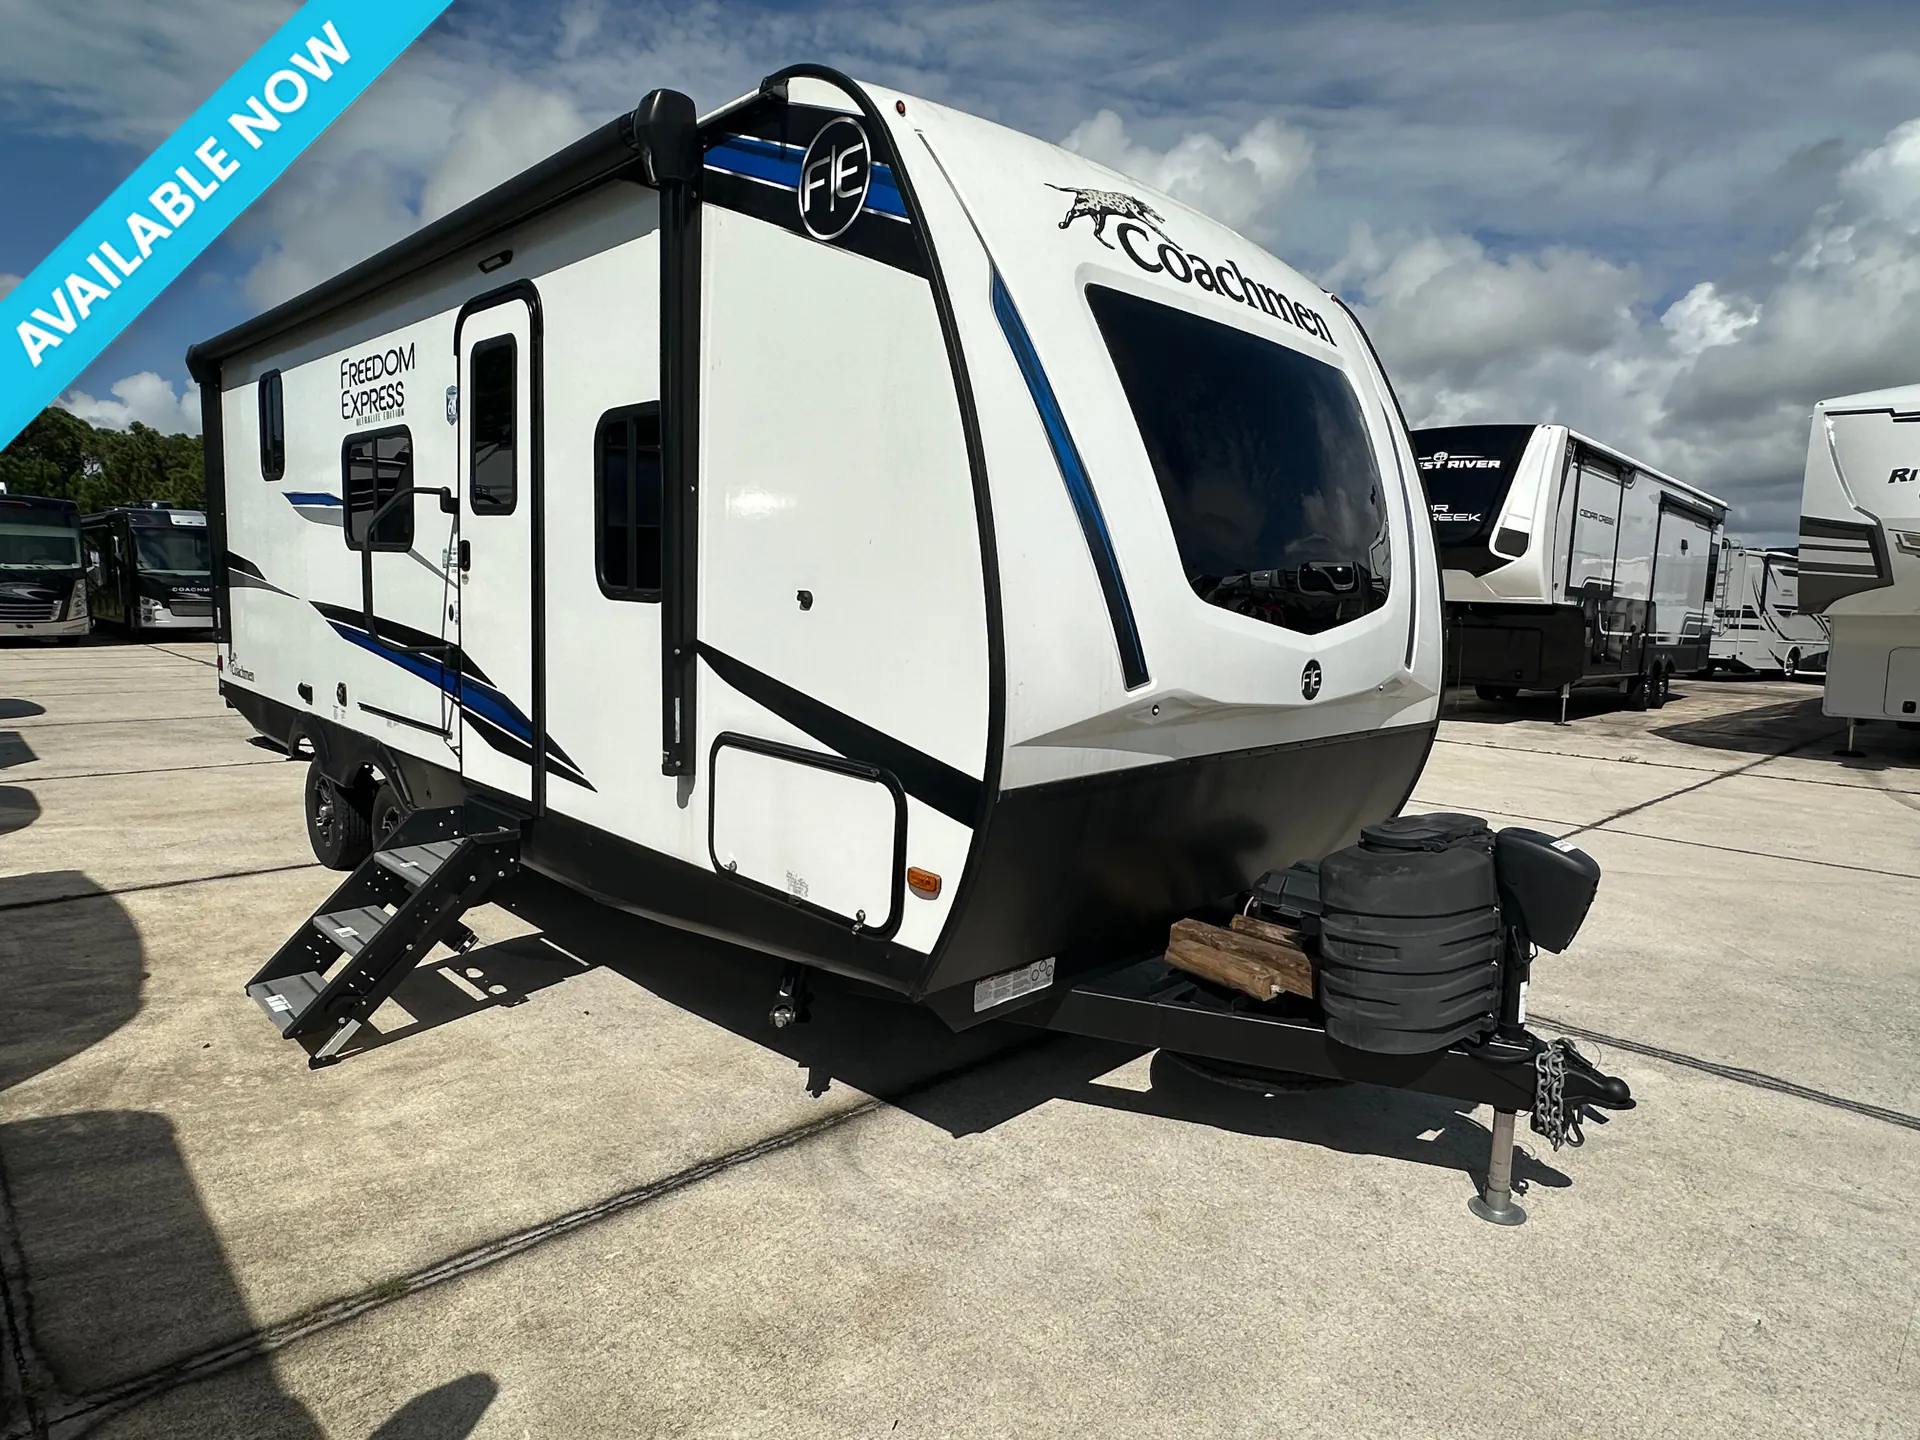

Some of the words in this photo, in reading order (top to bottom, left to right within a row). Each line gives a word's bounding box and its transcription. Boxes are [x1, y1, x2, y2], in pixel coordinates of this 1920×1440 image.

[1116, 222, 1338, 348] Coachmen
[340, 342, 416, 389] FREEDOM
[341, 380, 405, 420] EXPRESS
[383, 407, 405, 420] EDITION
[1446, 460, 1501, 469] RIVER
[1887, 468, 1920, 484] RI
